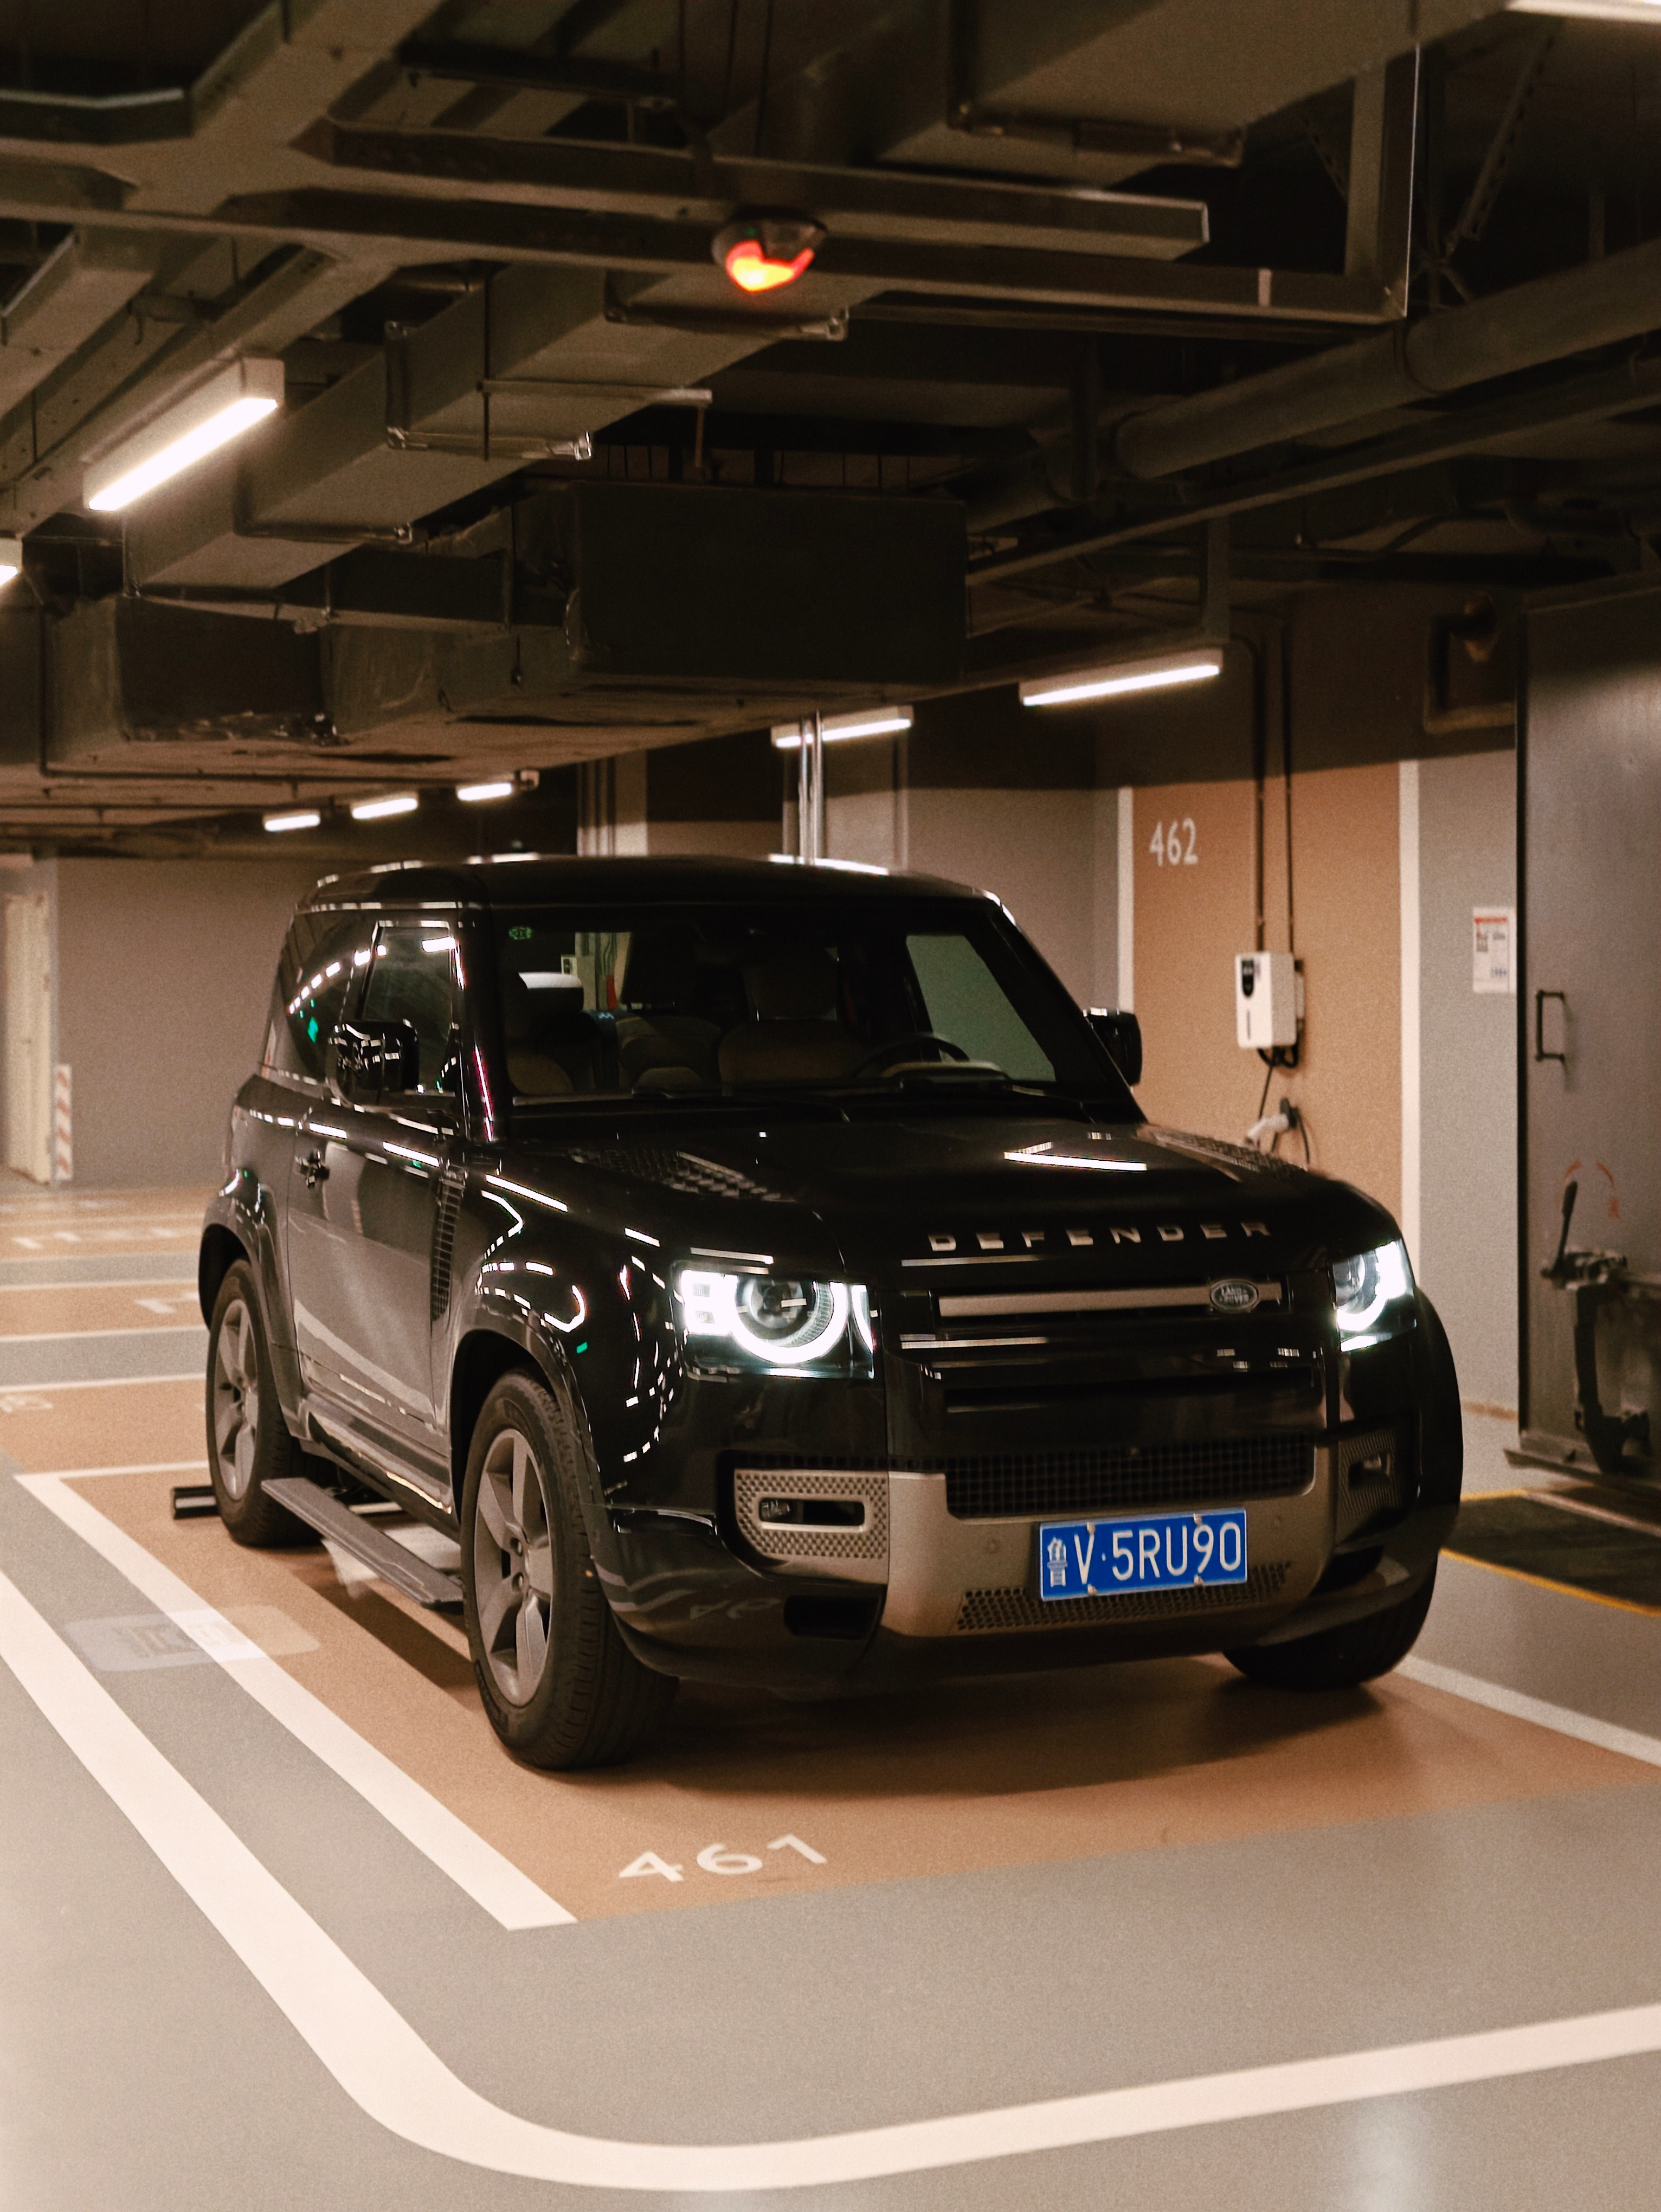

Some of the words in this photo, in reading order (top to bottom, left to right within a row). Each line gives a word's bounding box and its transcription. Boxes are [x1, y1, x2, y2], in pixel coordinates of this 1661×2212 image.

[1149, 817, 1198, 867] 462
[928, 1221, 1271, 1251] DEFENDER
[619, 1834, 827, 1882] 461
